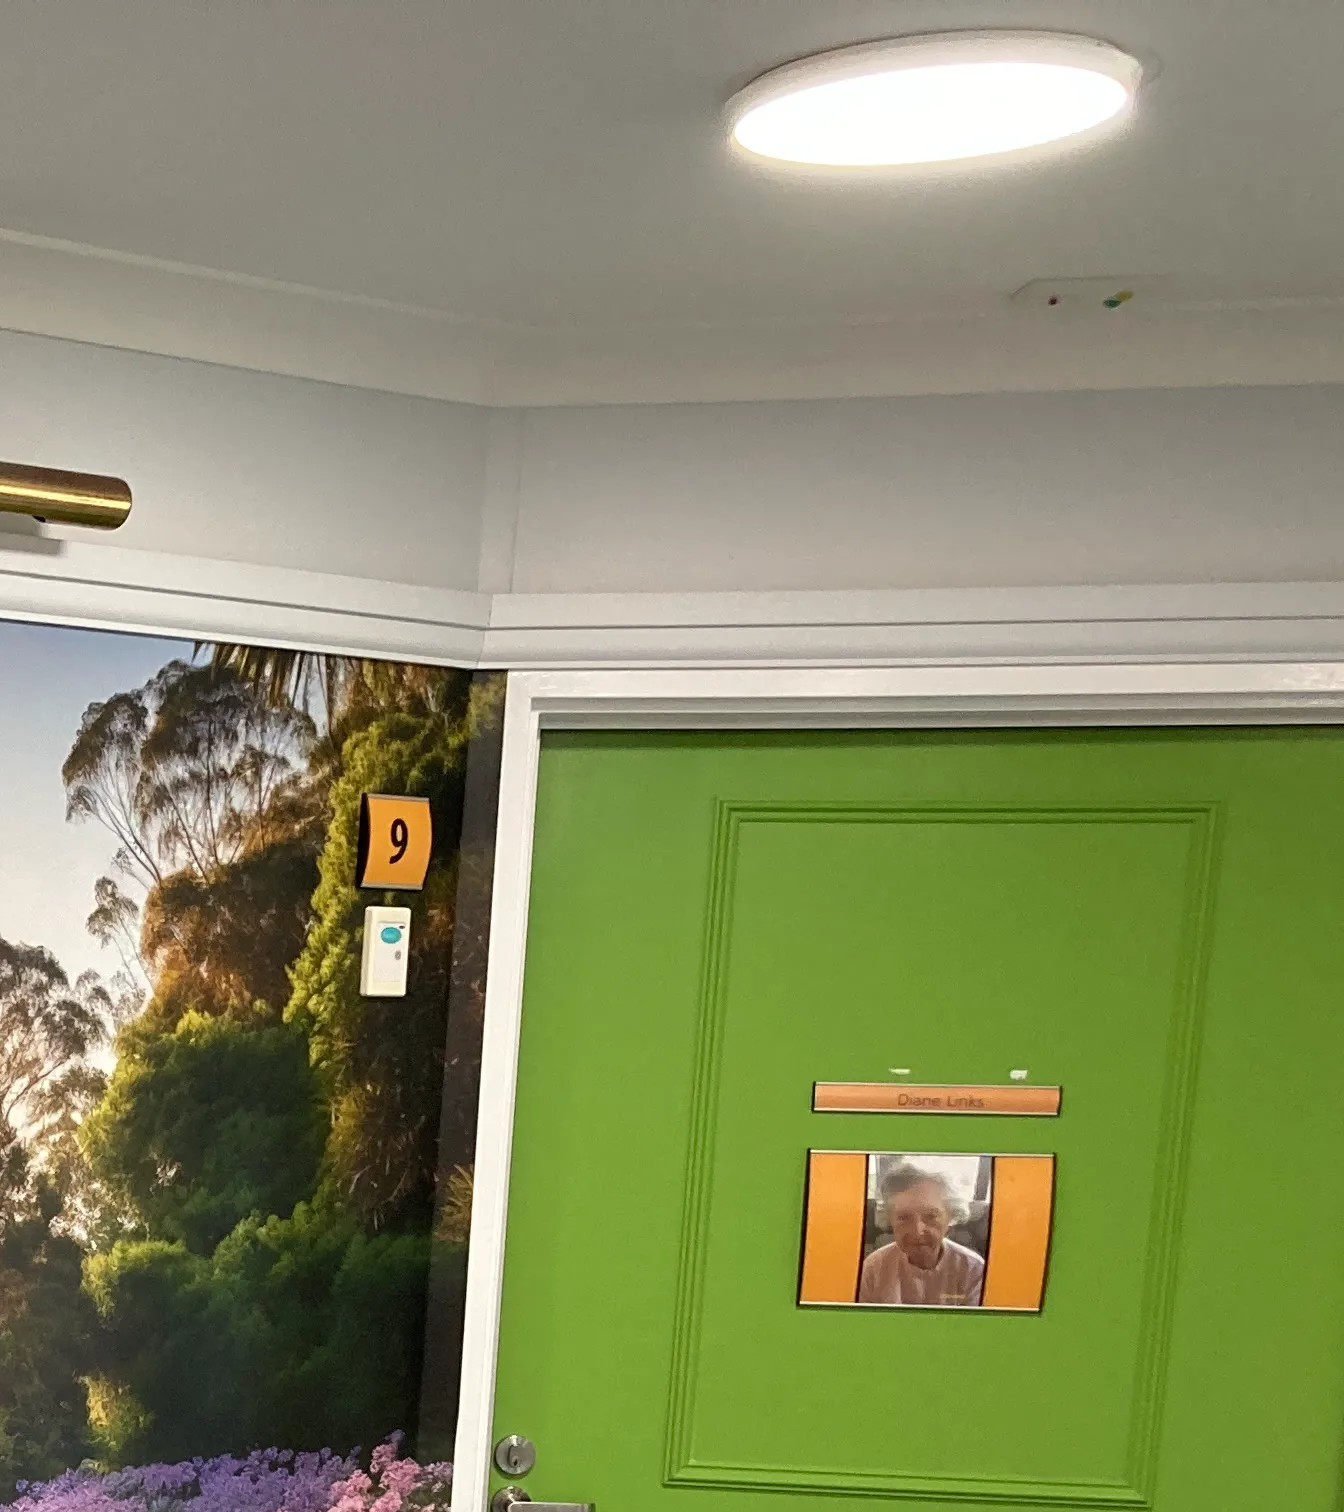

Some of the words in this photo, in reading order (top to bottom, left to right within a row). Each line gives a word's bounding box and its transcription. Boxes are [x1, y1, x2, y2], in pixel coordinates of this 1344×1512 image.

[389, 818, 409, 865] 9
[898, 1093, 941, 1108] Diane
[946, 1094, 985, 1109] Links
